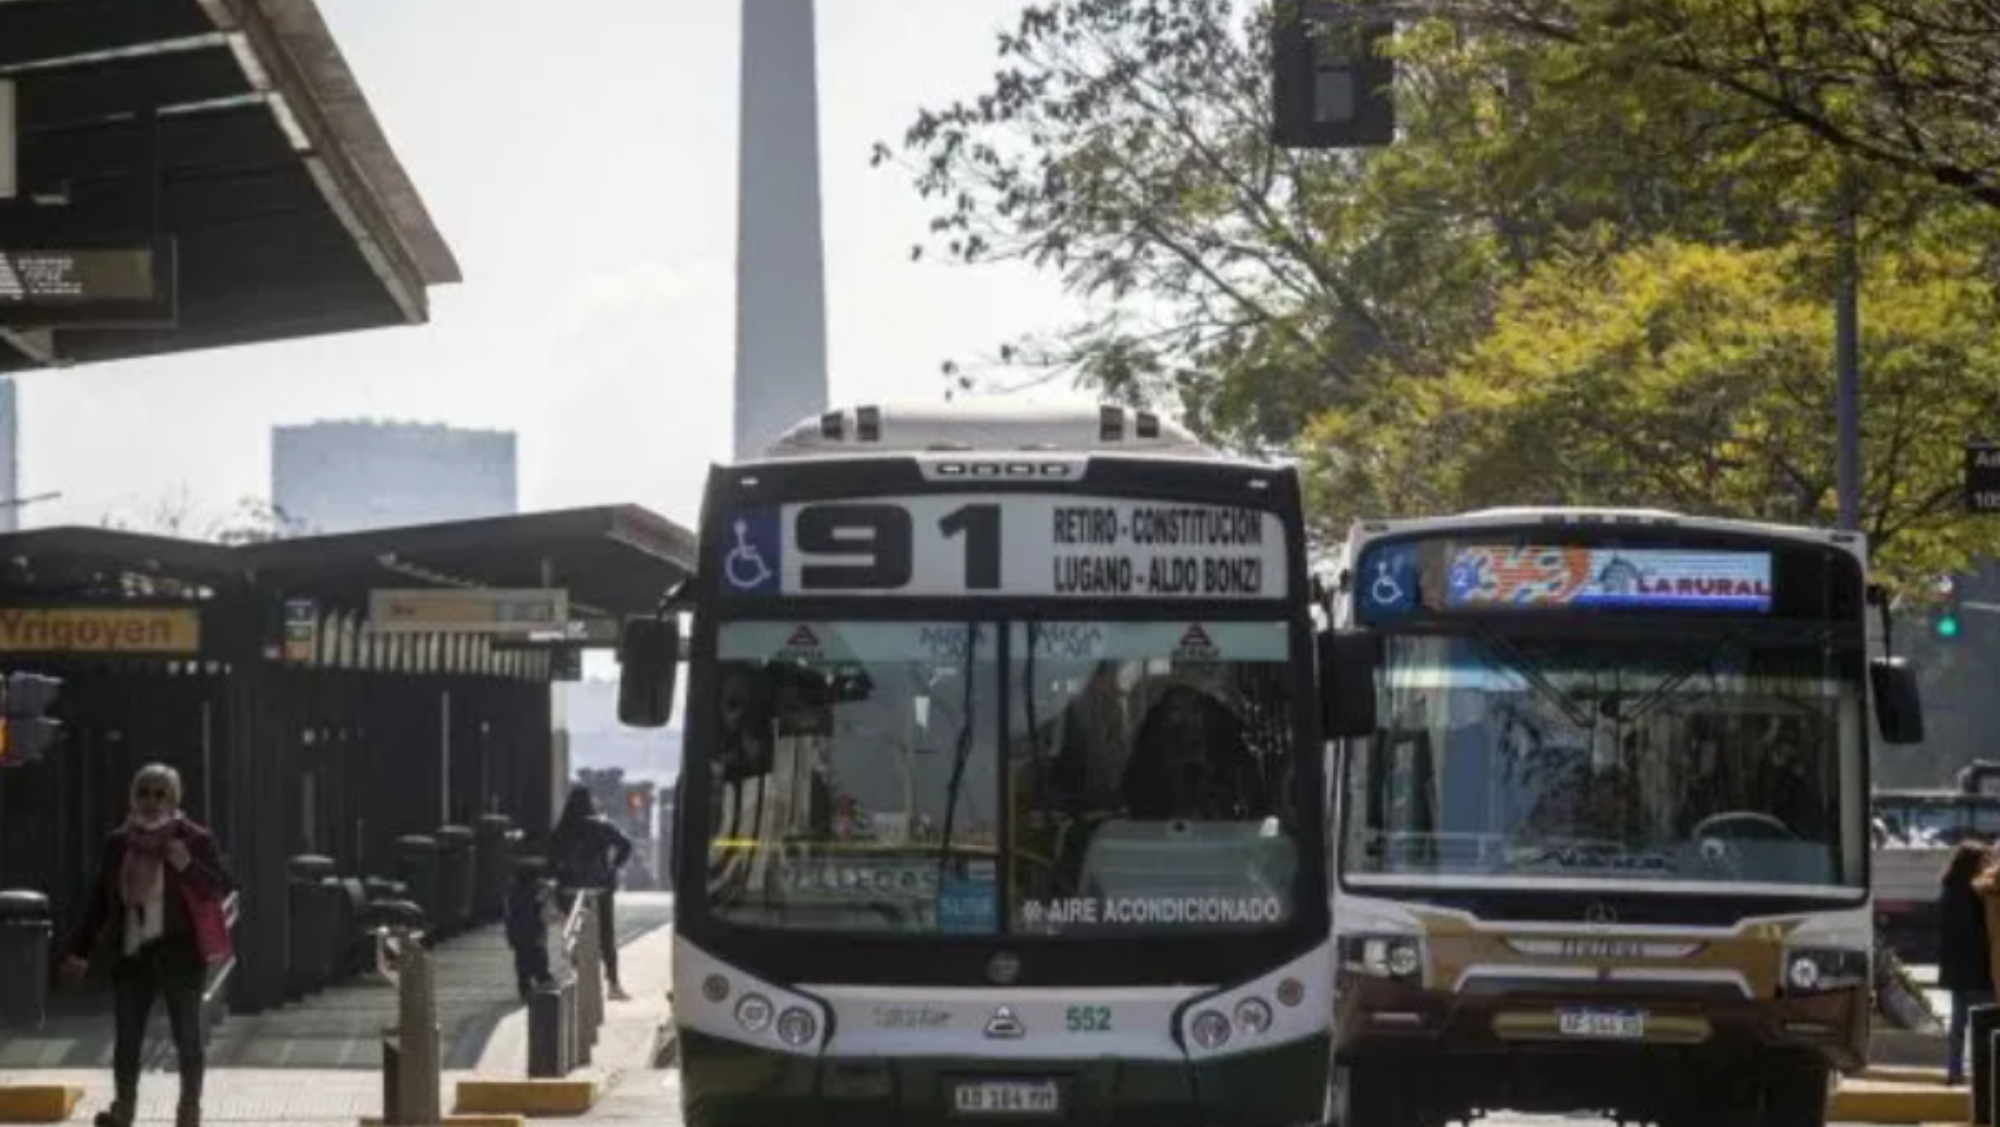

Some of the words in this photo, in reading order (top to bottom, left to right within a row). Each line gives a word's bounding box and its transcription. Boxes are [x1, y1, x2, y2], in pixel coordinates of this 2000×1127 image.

[1054, 508, 1117, 544] RETIRO
[795, 503, 1002, 590] 91
[1054, 556, 1131, 593] LUGANO
[1149, 556, 1199, 593] ALDO
[1204, 557, 1263, 593] BONZI
[1636, 576, 1672, 594] LA
[1676, 578, 1770, 596] RURAL
[0, 608, 174, 651] Yrigoyen
[1049, 899, 1097, 922] AIRE
[1103, 898, 1281, 922] ACONDICIONADO
[1066, 1005, 1111, 1031] 552
